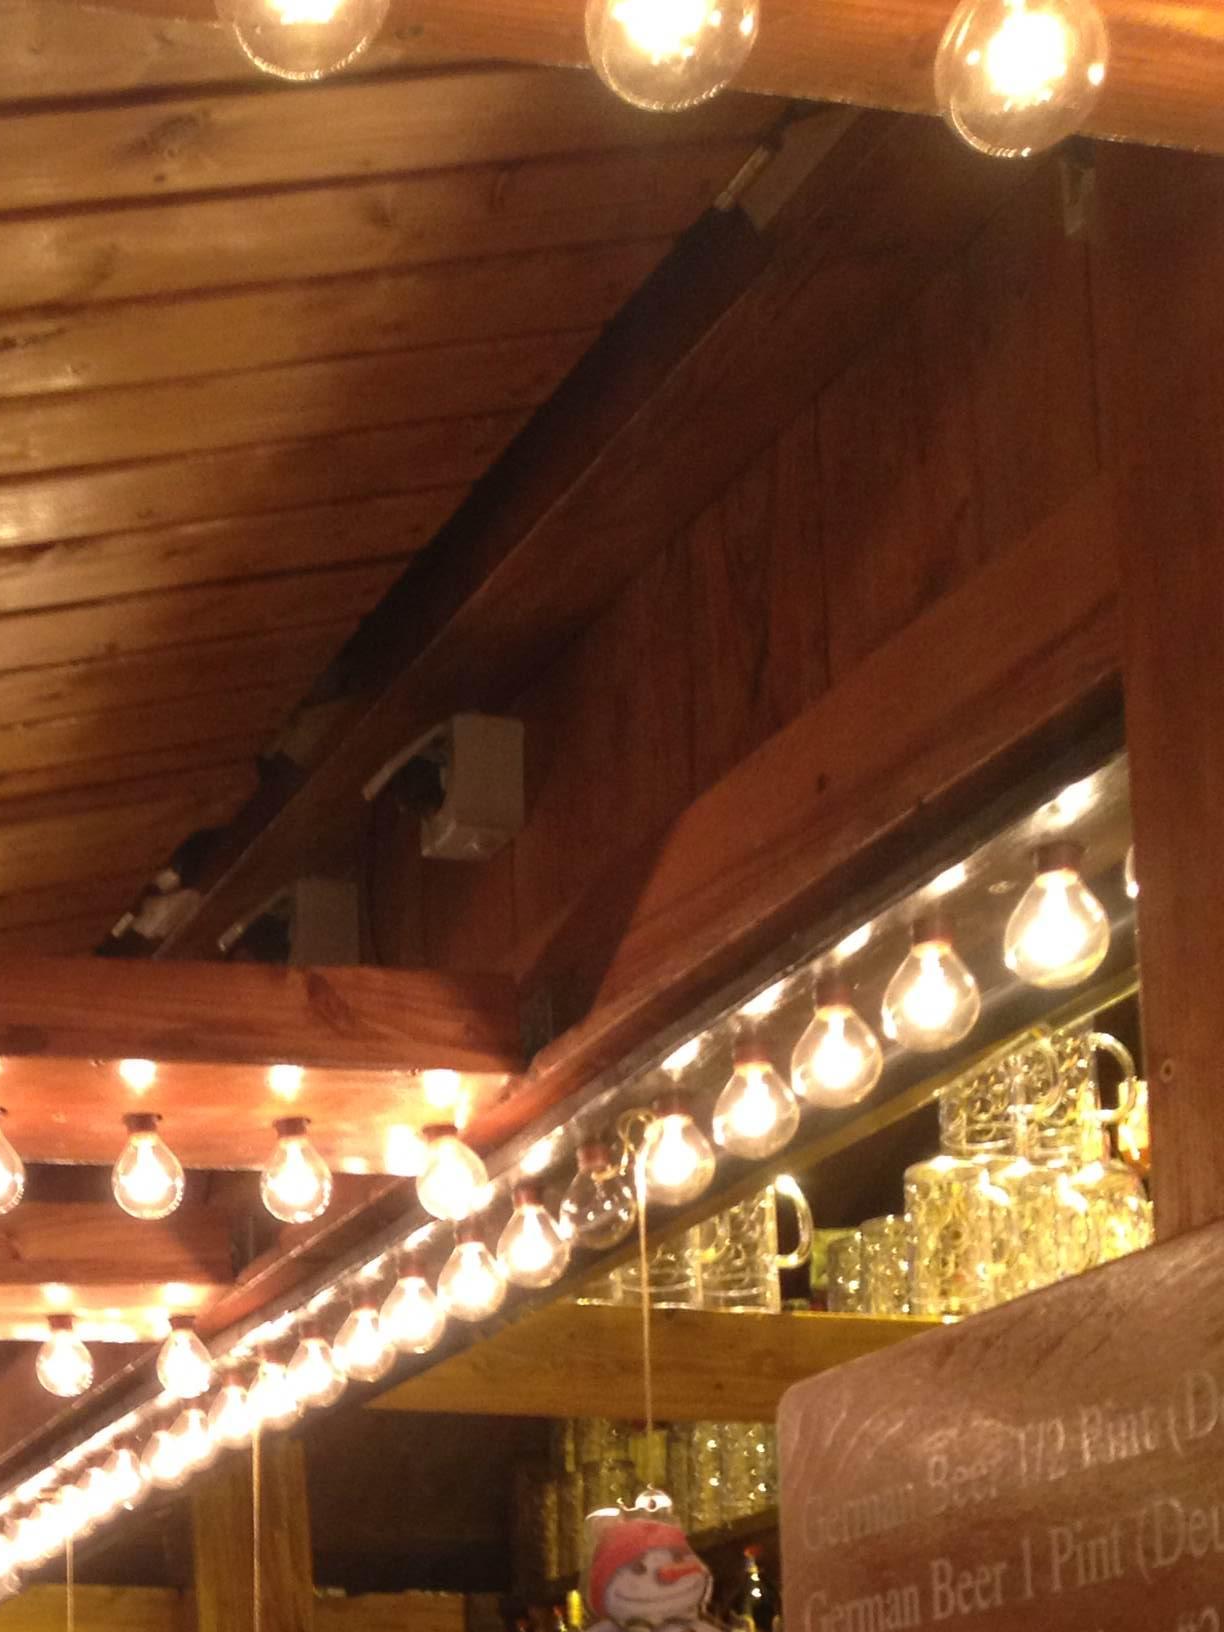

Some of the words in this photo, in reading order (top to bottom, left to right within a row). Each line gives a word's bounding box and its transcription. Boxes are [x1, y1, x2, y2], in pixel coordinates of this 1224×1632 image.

[1167, 1368, 1224, 1455] (D
[929, 1557, 1008, 1620] Beer
[1048, 1522, 1124, 1593] Pint
